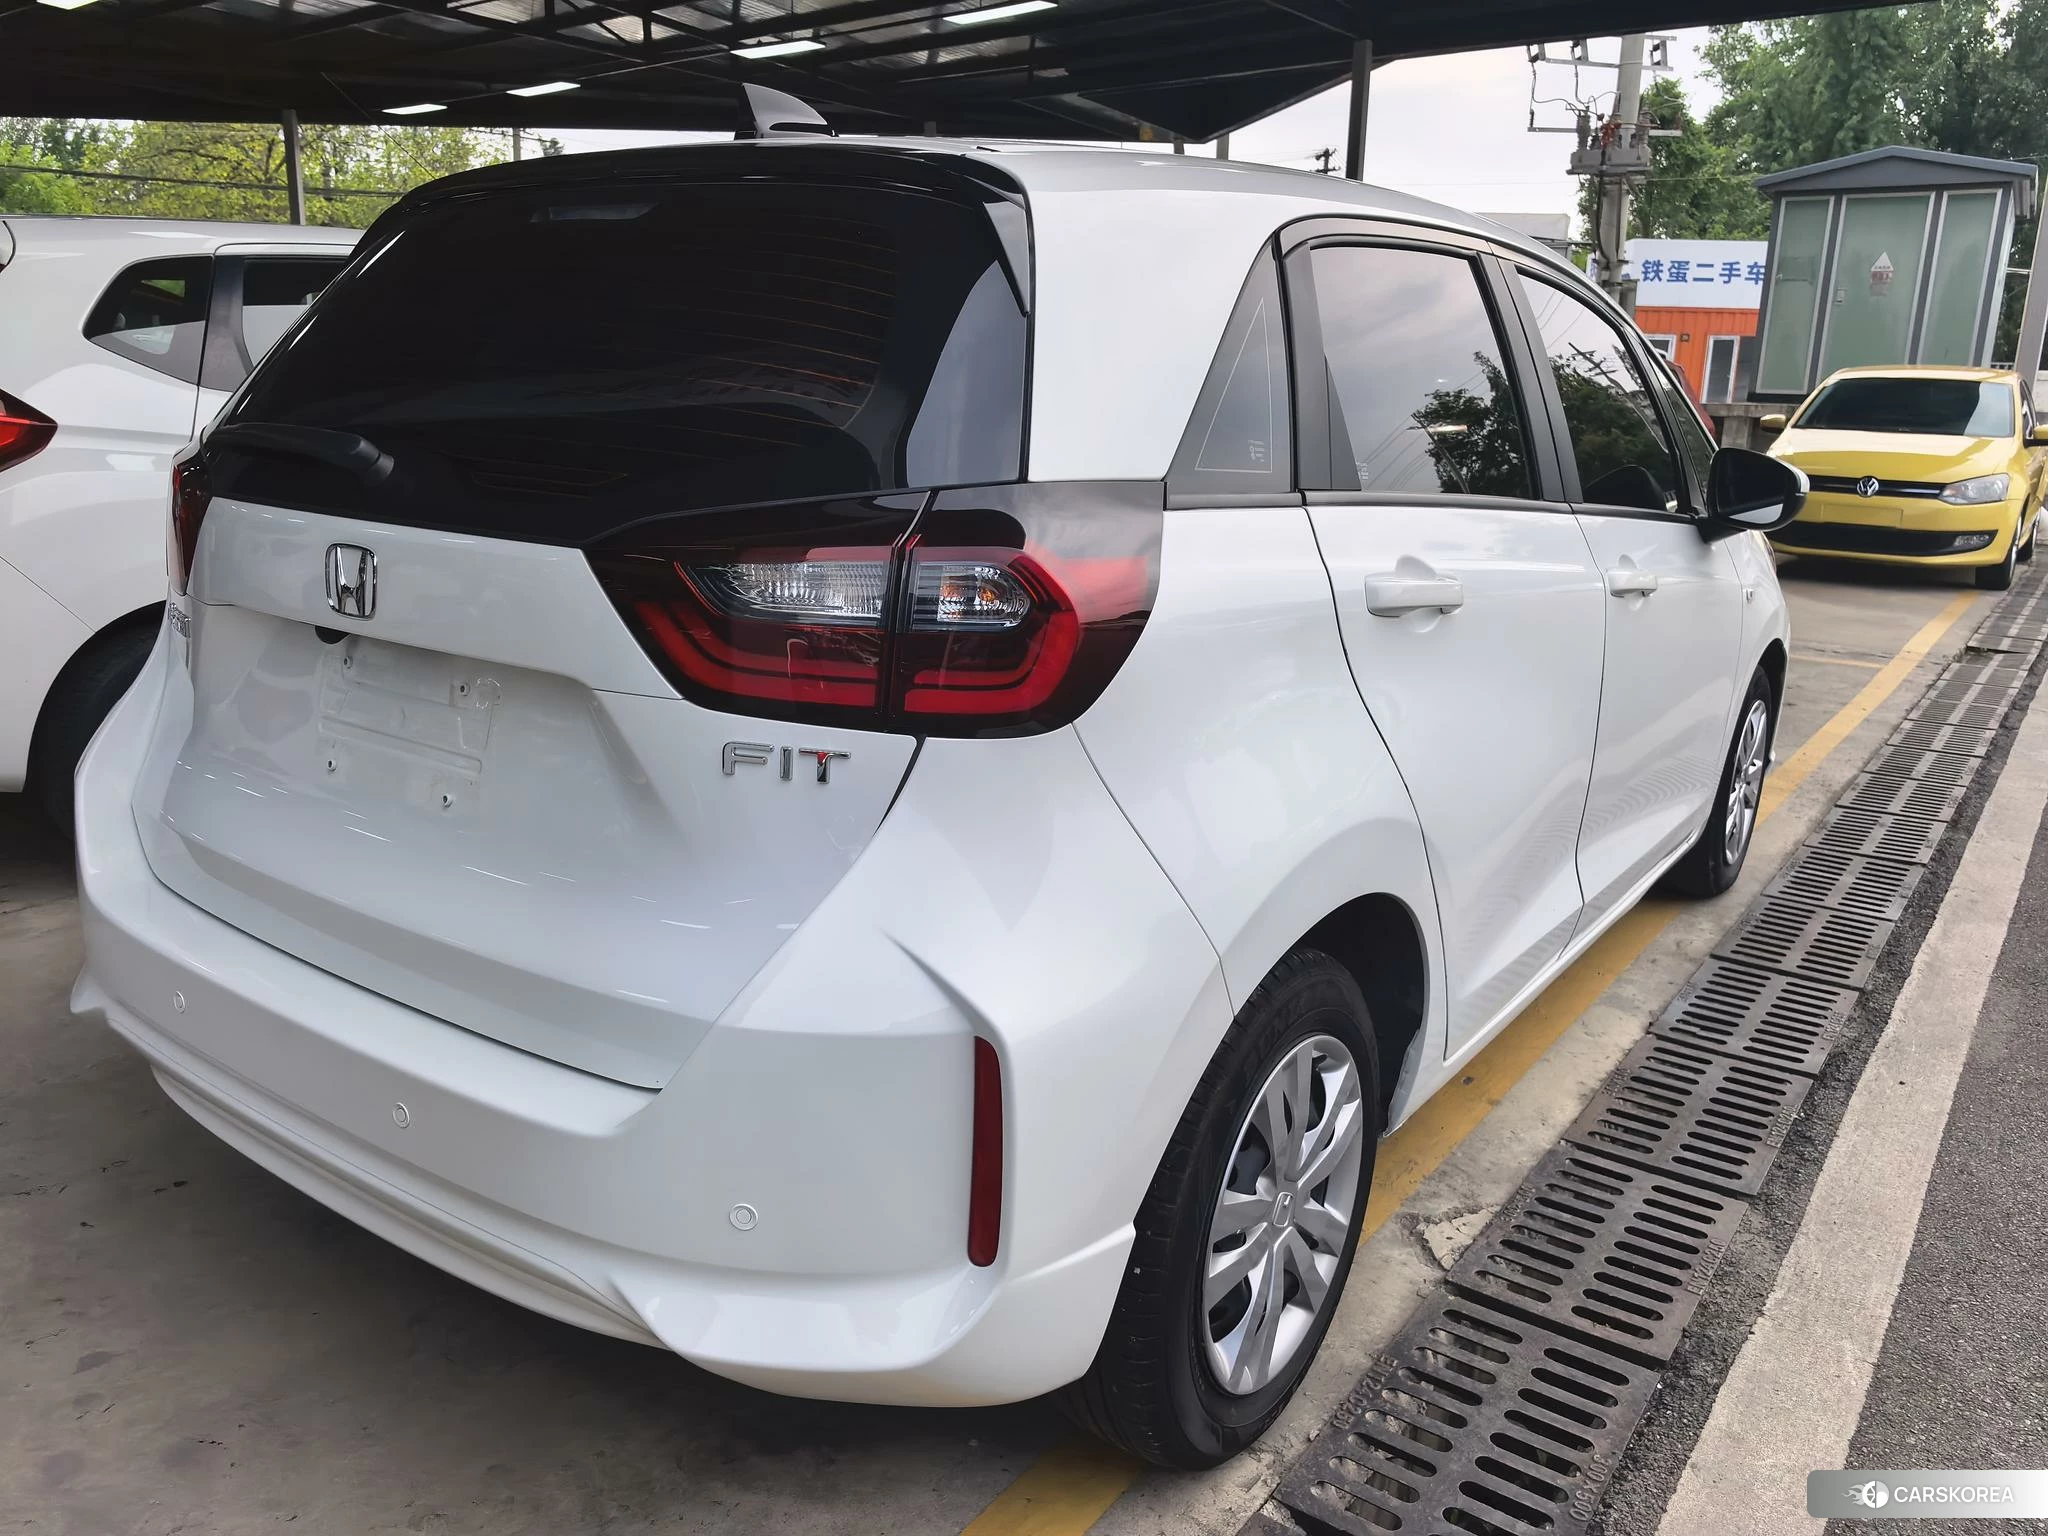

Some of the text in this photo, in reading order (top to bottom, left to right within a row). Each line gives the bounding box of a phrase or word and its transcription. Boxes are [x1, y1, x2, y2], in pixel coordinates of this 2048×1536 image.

[1641, 260, 1766, 285] 铁蛋二手车
[722, 741, 851, 784] FIT
